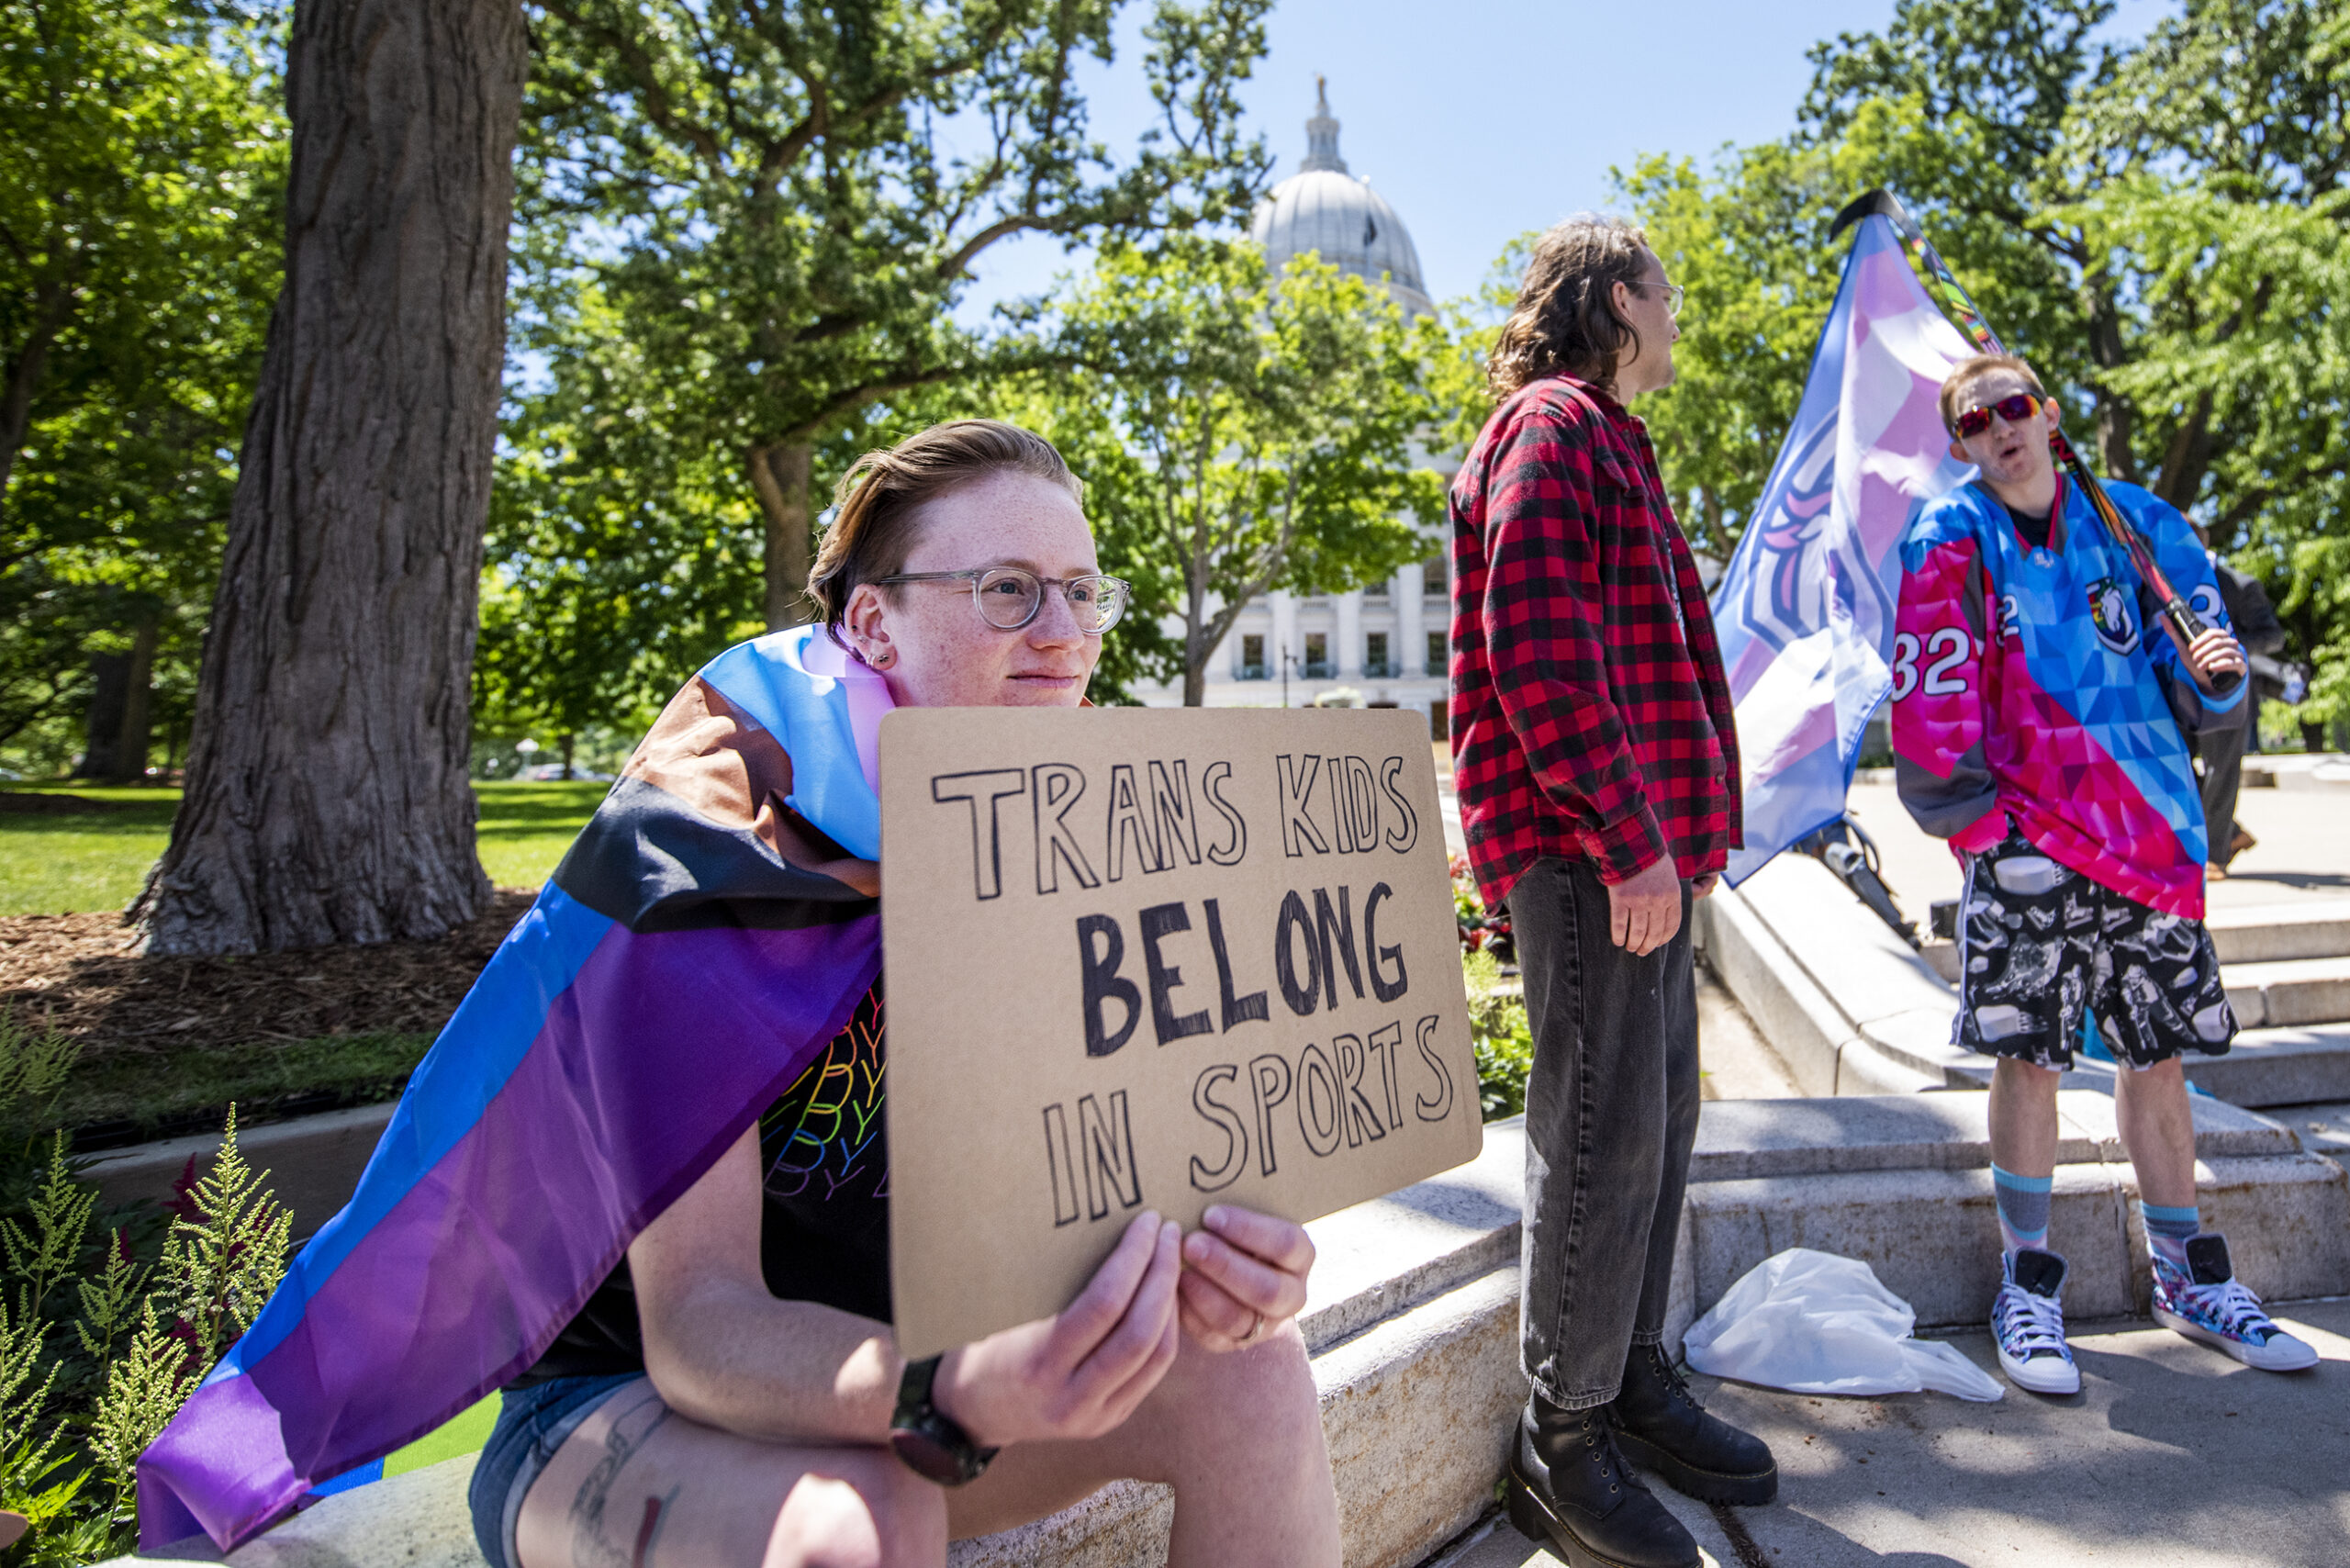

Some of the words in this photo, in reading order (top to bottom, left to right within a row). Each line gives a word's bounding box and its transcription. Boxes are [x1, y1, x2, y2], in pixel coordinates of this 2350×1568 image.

[1892, 627, 1970, 703] 32
[931, 758, 1248, 902] TRANS
[1275, 754, 1418, 857] KIDS
[1076, 881, 1408, 1058] BELONG
[1043, 1089, 1144, 1228] IN
[1189, 1014, 1454, 1193] SPORTS
